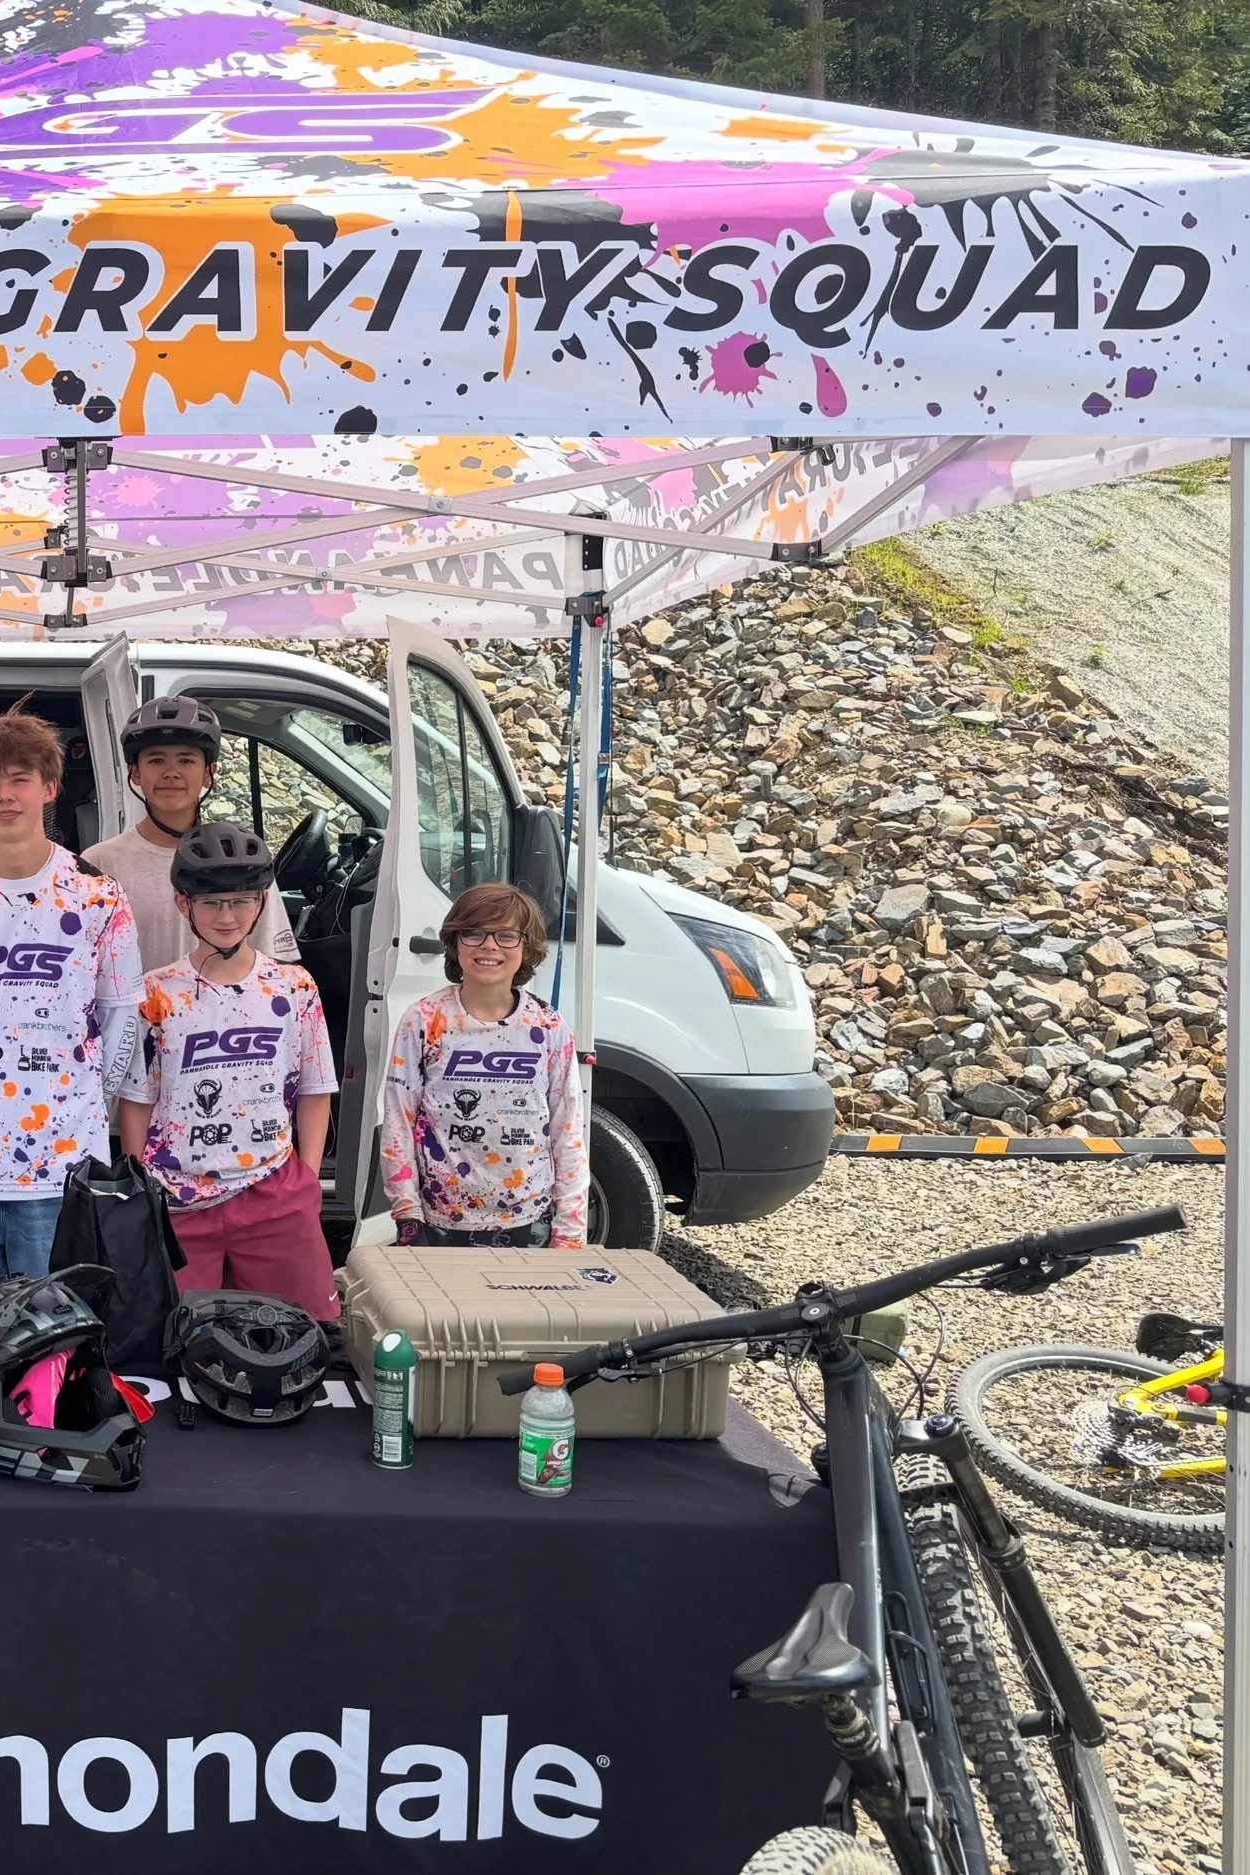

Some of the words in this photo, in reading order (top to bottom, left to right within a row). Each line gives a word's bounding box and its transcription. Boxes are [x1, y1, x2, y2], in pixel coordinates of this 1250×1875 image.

[666, 243, 1211, 349] SQUAD
[35, 980, 59, 988] SQUAD
[181, 1026, 284, 1069] PGS
[31, 1062, 45, 1072] BIKE
[221, 1061, 254, 1069] GRAVITY
[443, 1050, 542, 1079] PGS
